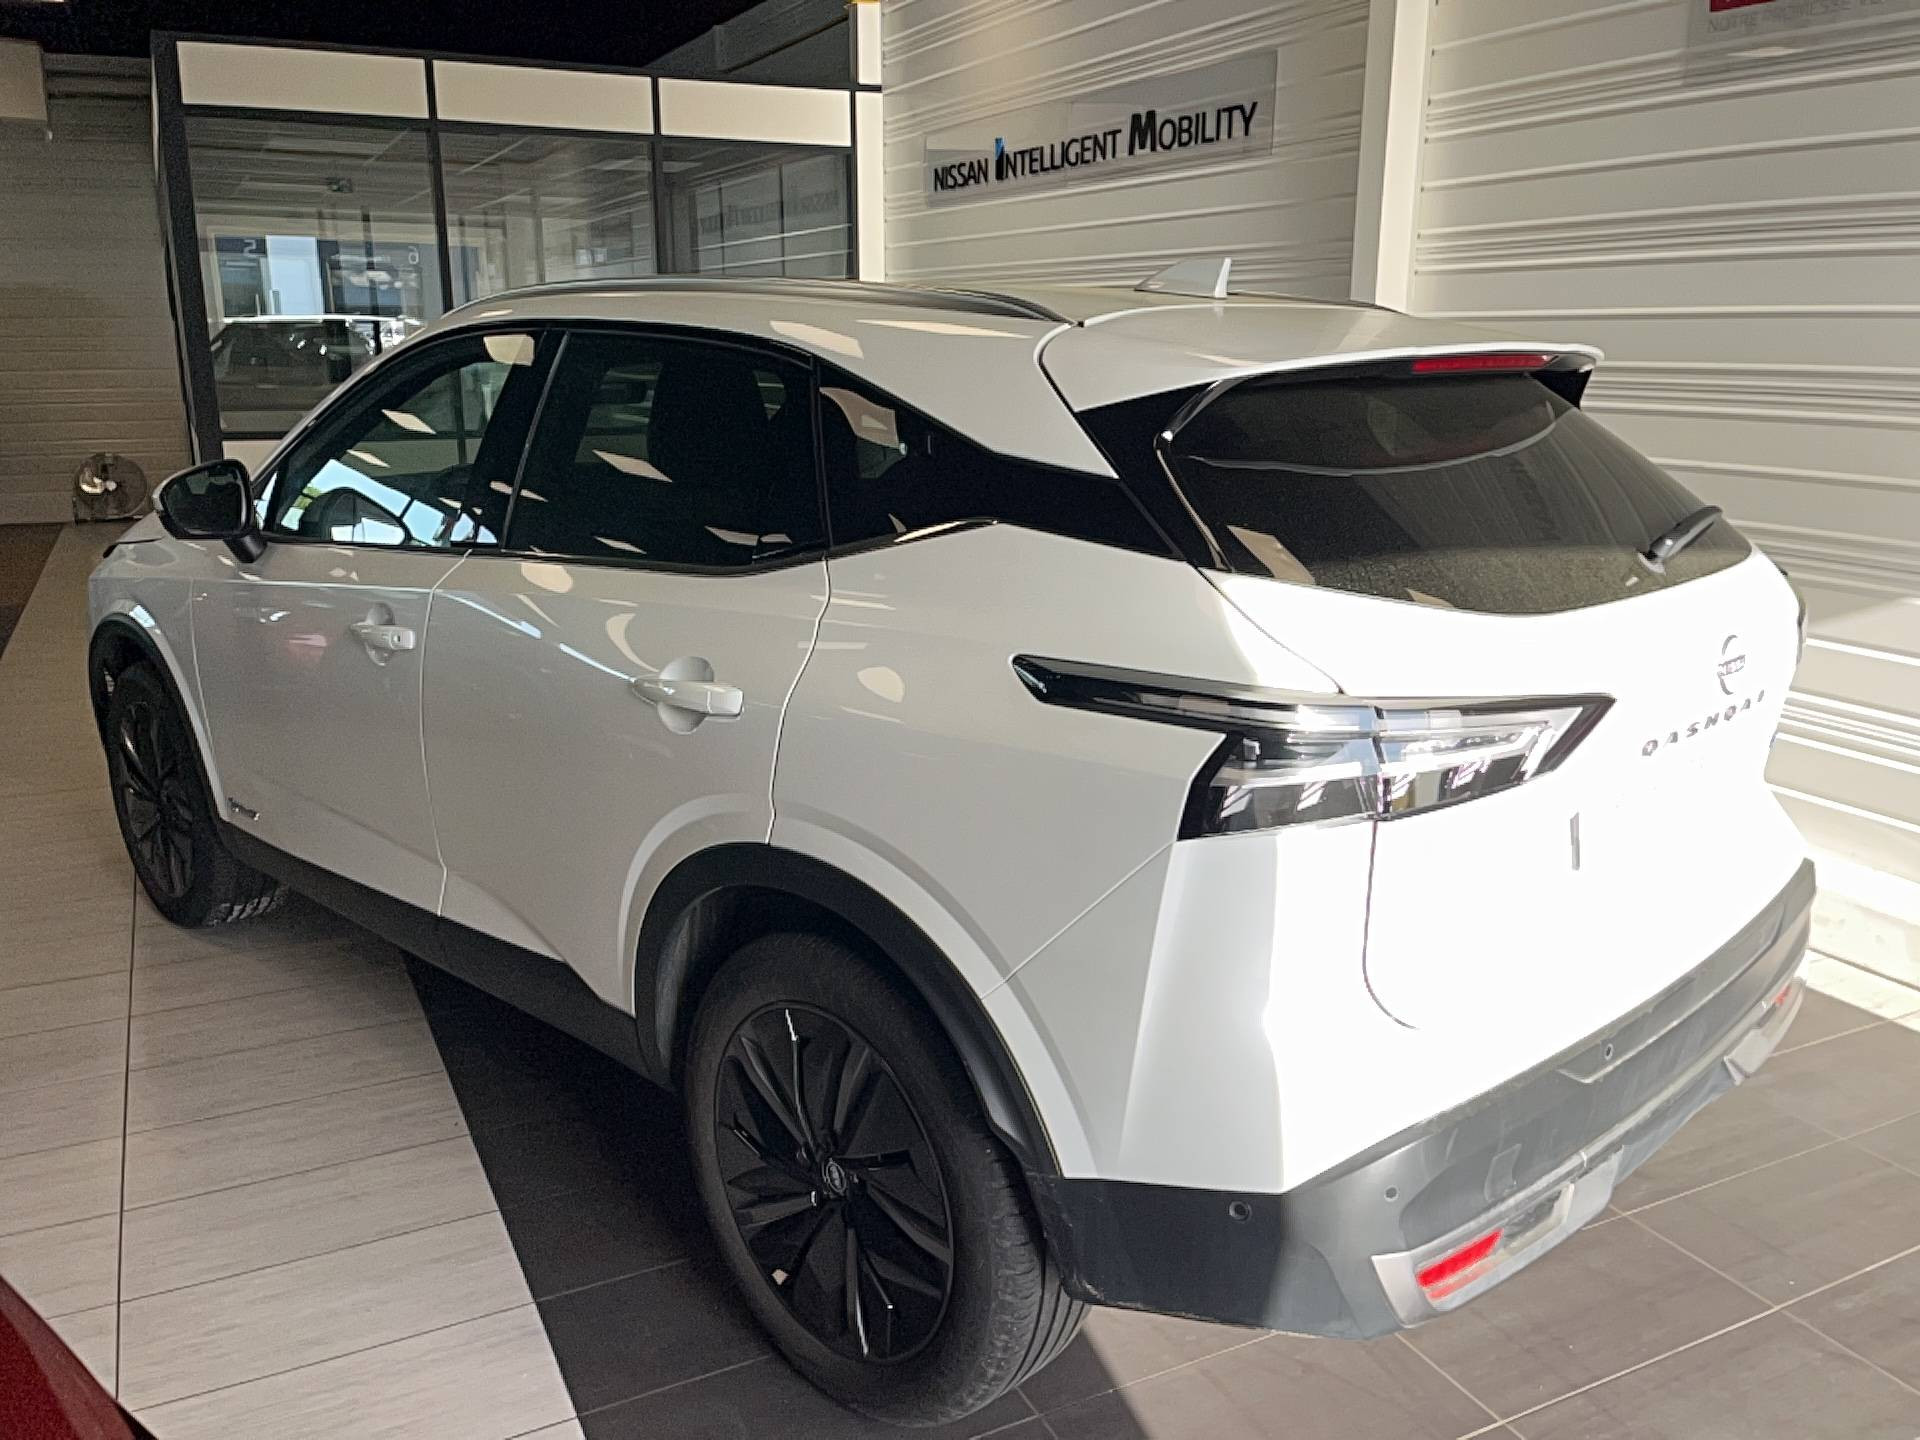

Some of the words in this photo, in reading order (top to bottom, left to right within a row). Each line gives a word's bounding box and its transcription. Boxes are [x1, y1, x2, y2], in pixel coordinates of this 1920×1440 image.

[933, 158, 989, 192] NISSAN
[995, 129, 1122, 181] INTELLIGENT
[1128, 101, 1258, 156] MOBILITY
[1642, 689, 1765, 757] QASHQAI
